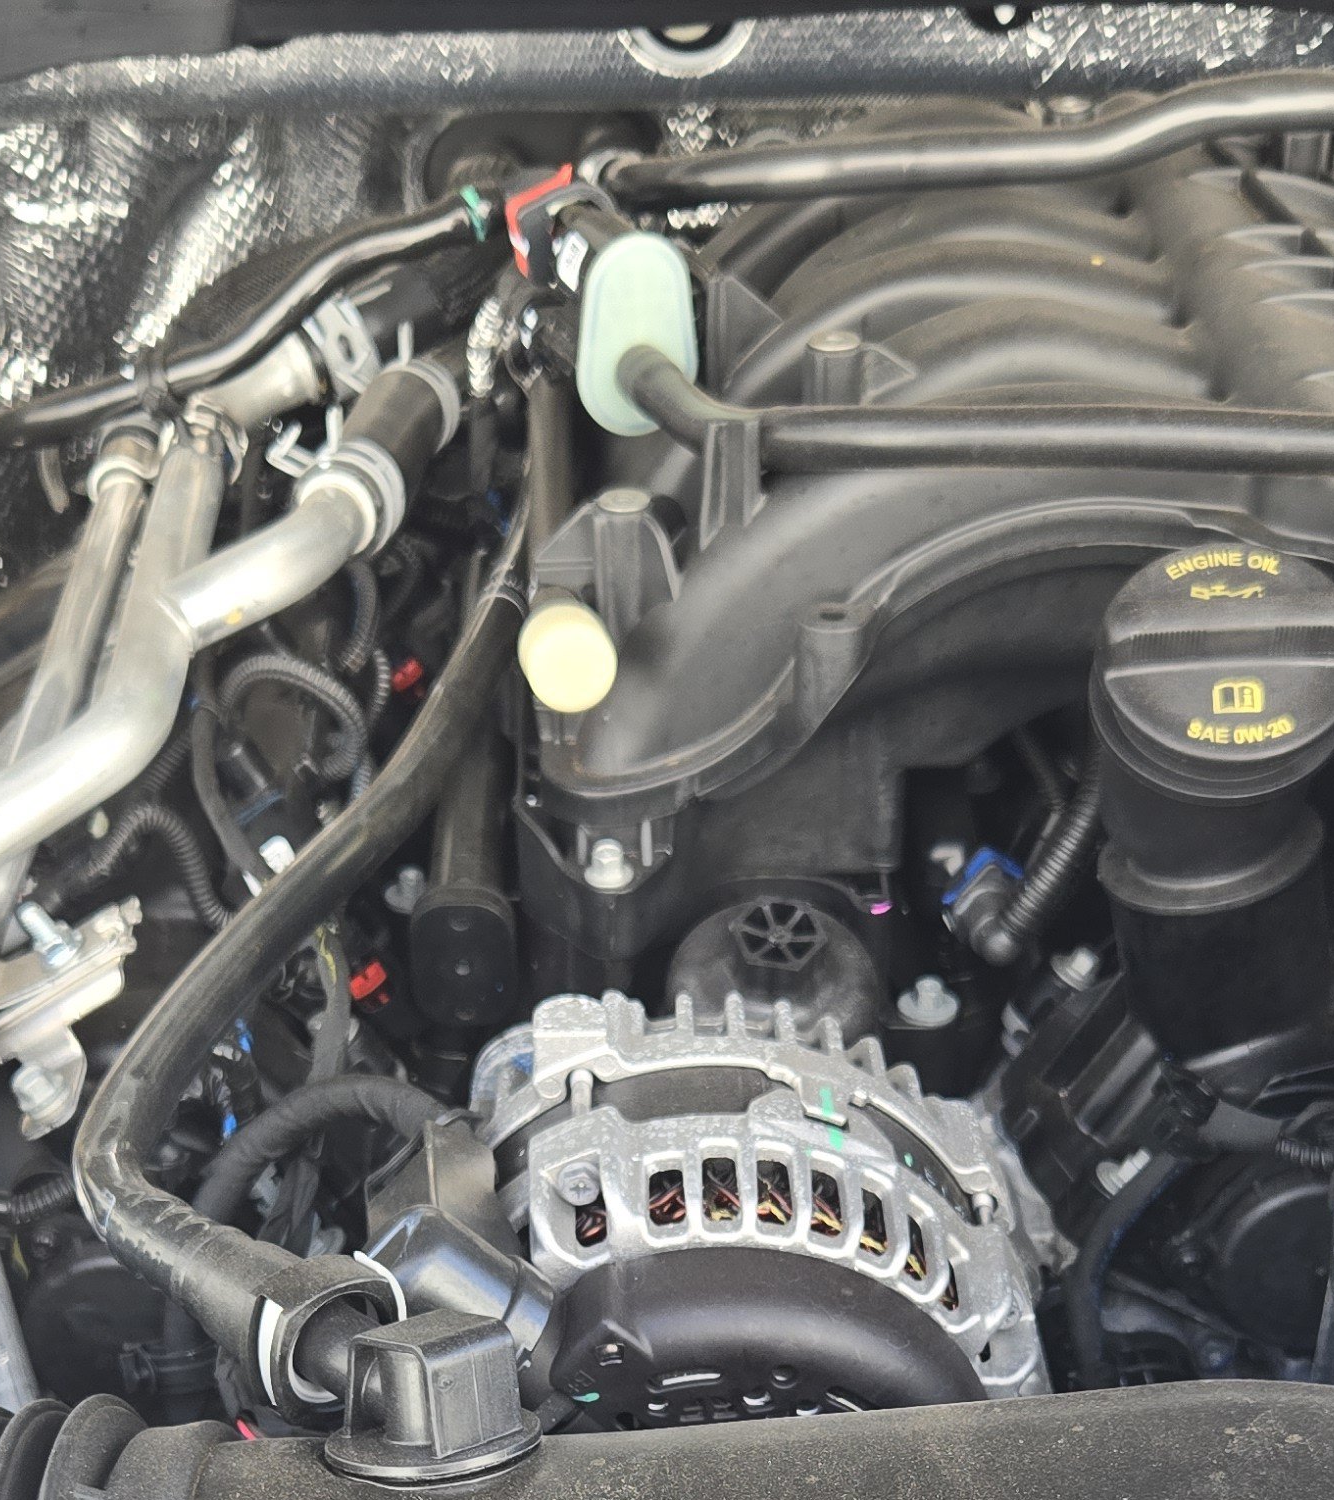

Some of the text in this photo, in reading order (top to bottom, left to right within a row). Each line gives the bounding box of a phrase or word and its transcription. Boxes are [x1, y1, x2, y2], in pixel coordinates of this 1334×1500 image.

[1166, 552, 1280, 580] ENGINE OIL
[1187, 716, 1293, 745] SAE 0W-20
